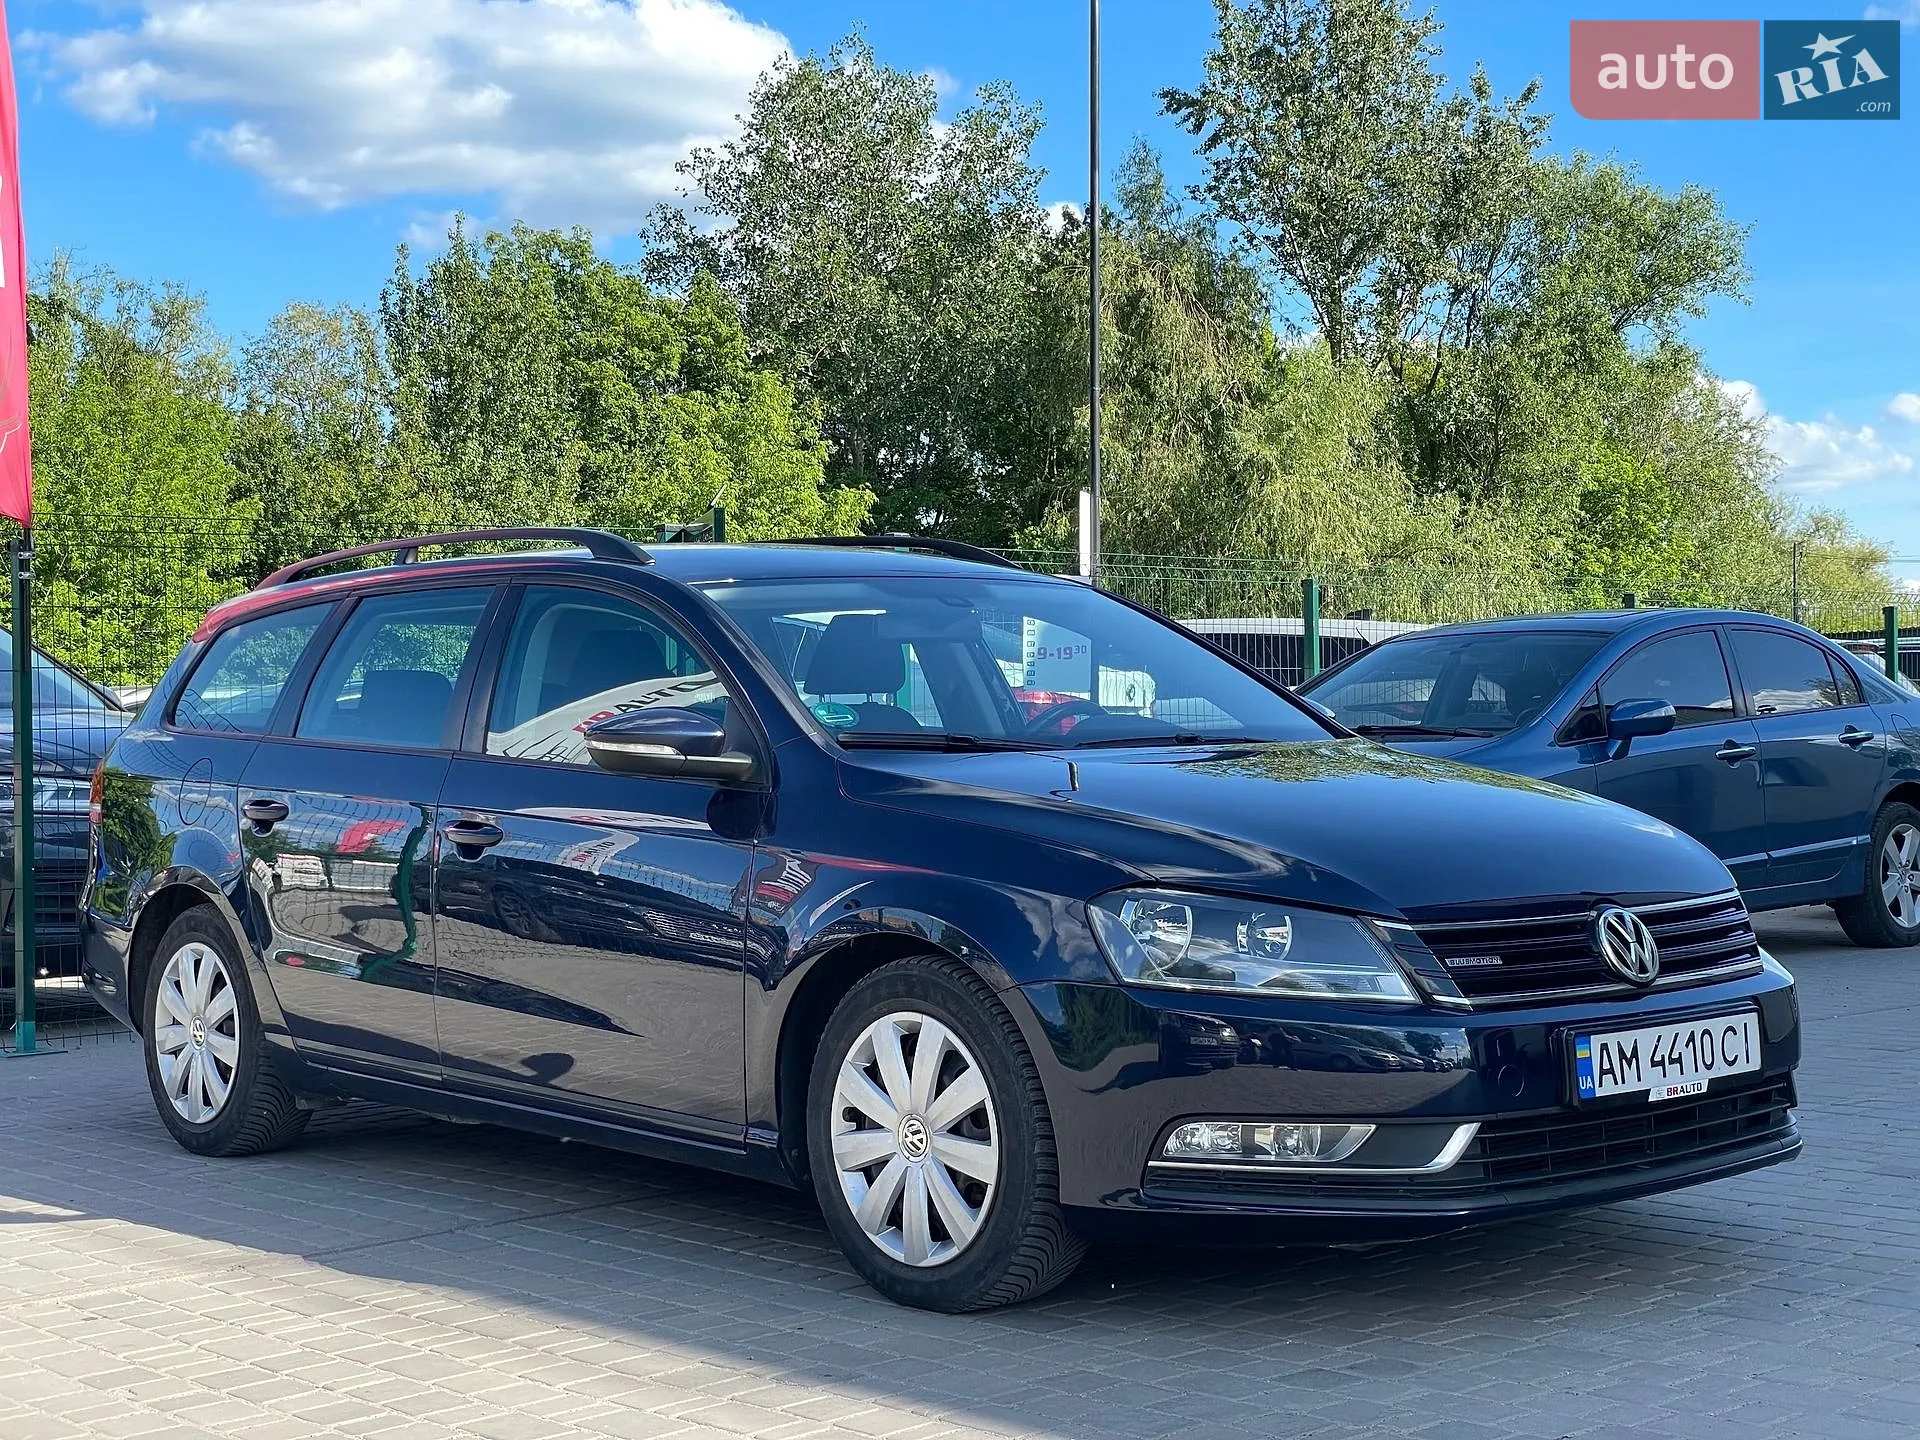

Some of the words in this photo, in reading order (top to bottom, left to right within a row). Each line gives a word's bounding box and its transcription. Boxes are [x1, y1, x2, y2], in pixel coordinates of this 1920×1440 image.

[1598, 1038, 1642, 1088] AM
[1650, 1028, 1715, 1078] 4410
[1721, 1022, 1750, 1067] CI
[1579, 1076, 1594, 1090] UA
[1666, 1082, 1703, 1097] BRAUTO
